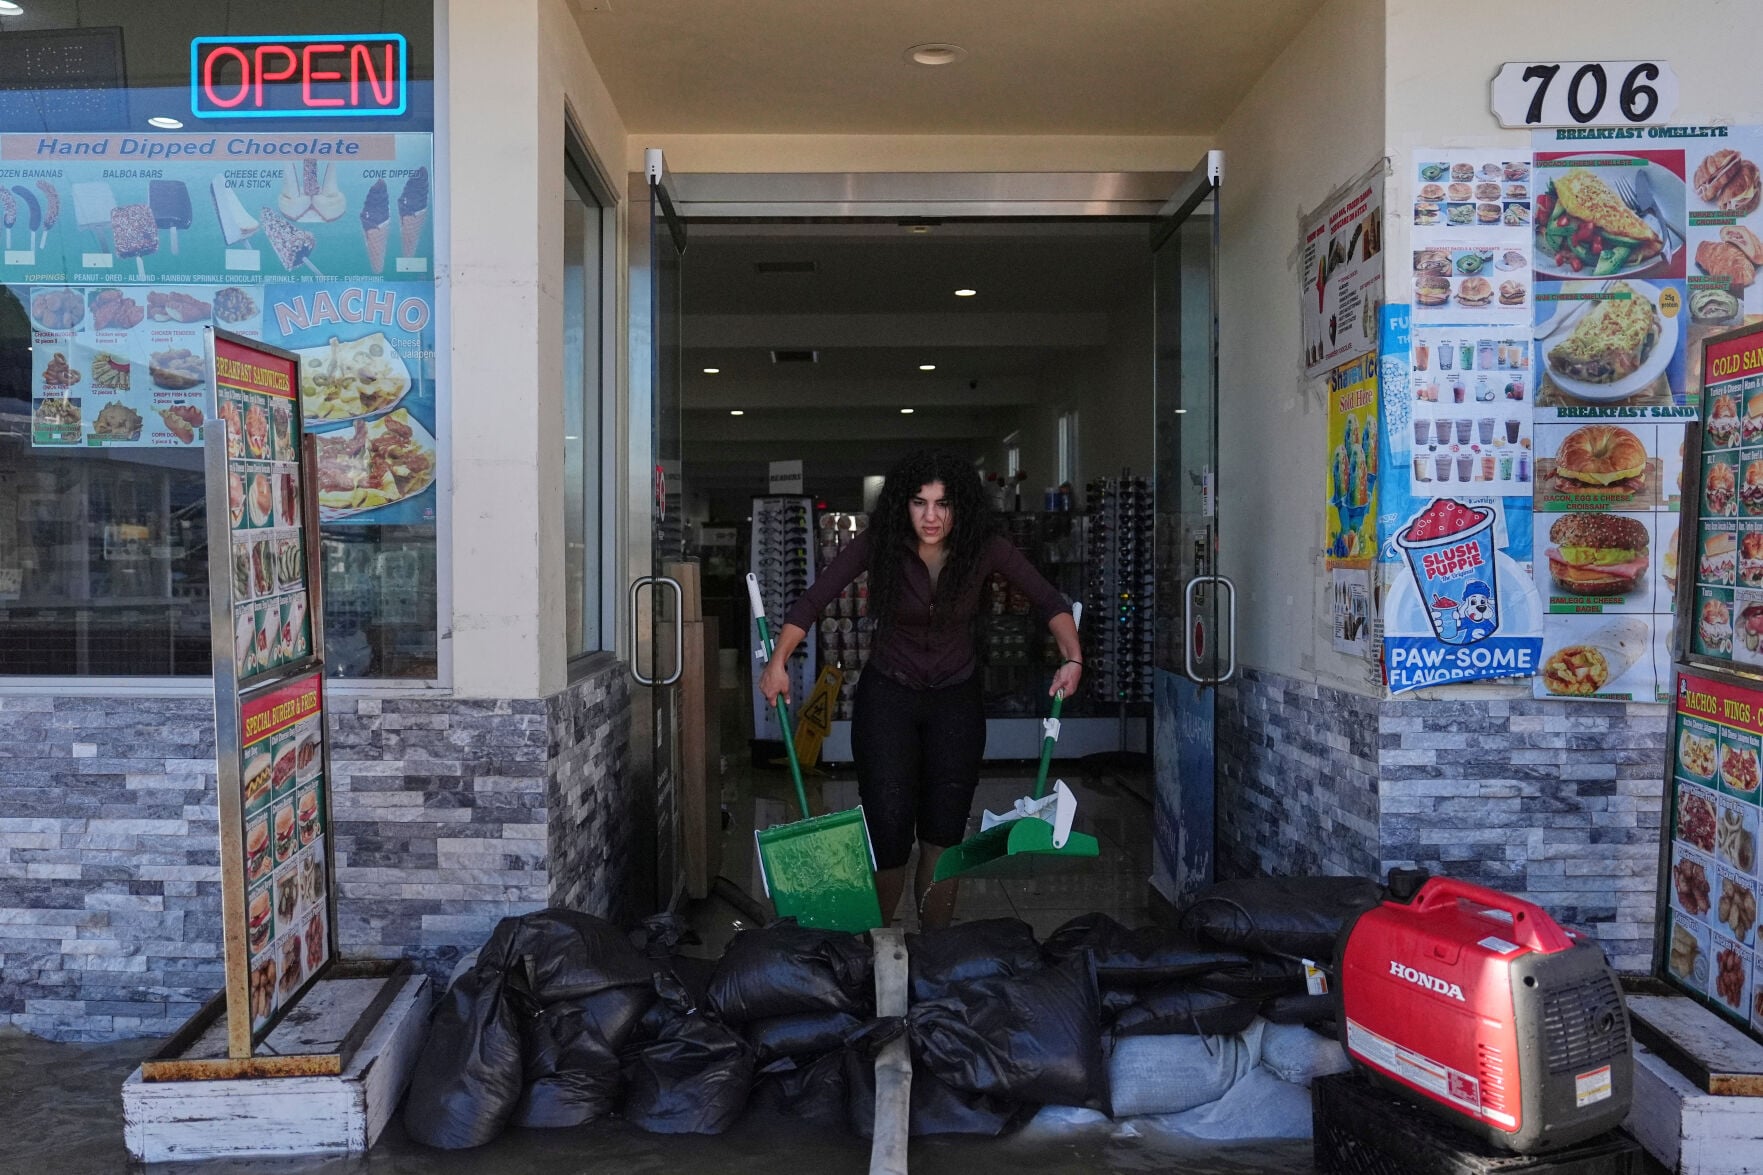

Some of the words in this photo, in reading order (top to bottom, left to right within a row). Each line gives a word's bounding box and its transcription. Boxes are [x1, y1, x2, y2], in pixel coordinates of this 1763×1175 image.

[25, 46, 85, 75] ICE
[204, 44, 393, 107] OPEN
[1523, 63, 1659, 123] 706
[1556, 127, 1643, 140] BREAKFAST
[1648, 126, 1728, 138] OMELLETE
[37, 139, 109, 154] Hand
[119, 139, 216, 158] Dipped
[227, 138, 359, 154] Chocolate
[22, 170, 63, 178] BANANAS
[102, 170, 138, 178] BALBOA
[139, 170, 163, 178] BARS
[224, 170, 258, 178] CHEESE
[260, 170, 284, 178] CAKE
[225, 180, 237, 188] ON
[238, 180, 245, 188] A
[247, 180, 271, 188] STICK
[363, 170, 387, 178] CONE
[389, 170, 419, 178] DIPPED
[74, 274, 98, 282] PEANUT
[161, 274, 191, 282] RAINBOW
[274, 288, 430, 336] NACHO
[1661, 301, 1678, 309] protein
[391, 338, 421, 347] Cheese
[217, 357, 252, 383] BREAKFAST
[254, 366, 290, 391] SANDWICHES
[1713, 354, 1740, 377] COLD
[1331, 363, 1363, 392] Shaved
[1340, 393, 1355, 412] Sold
[1357, 388, 1373, 407] Here
[1557, 407, 1648, 417] BREAKFAST
[1422, 541, 1479, 568] SLUSH
[1441, 573, 1452, 582] The
[1453, 568, 1475, 581] Original
[1391, 648, 1531, 668] PAW-SOME
[246, 710, 271, 737] SPECIAL
[272, 700, 295, 726] BURGER
[296, 697, 301, 714] &
[301, 690, 317, 713] FRIES
[1686, 690, 1717, 714] NACHOS
[1724, 699, 1750, 723] WINGS
[1390, 961, 1465, 1001] HONDA
